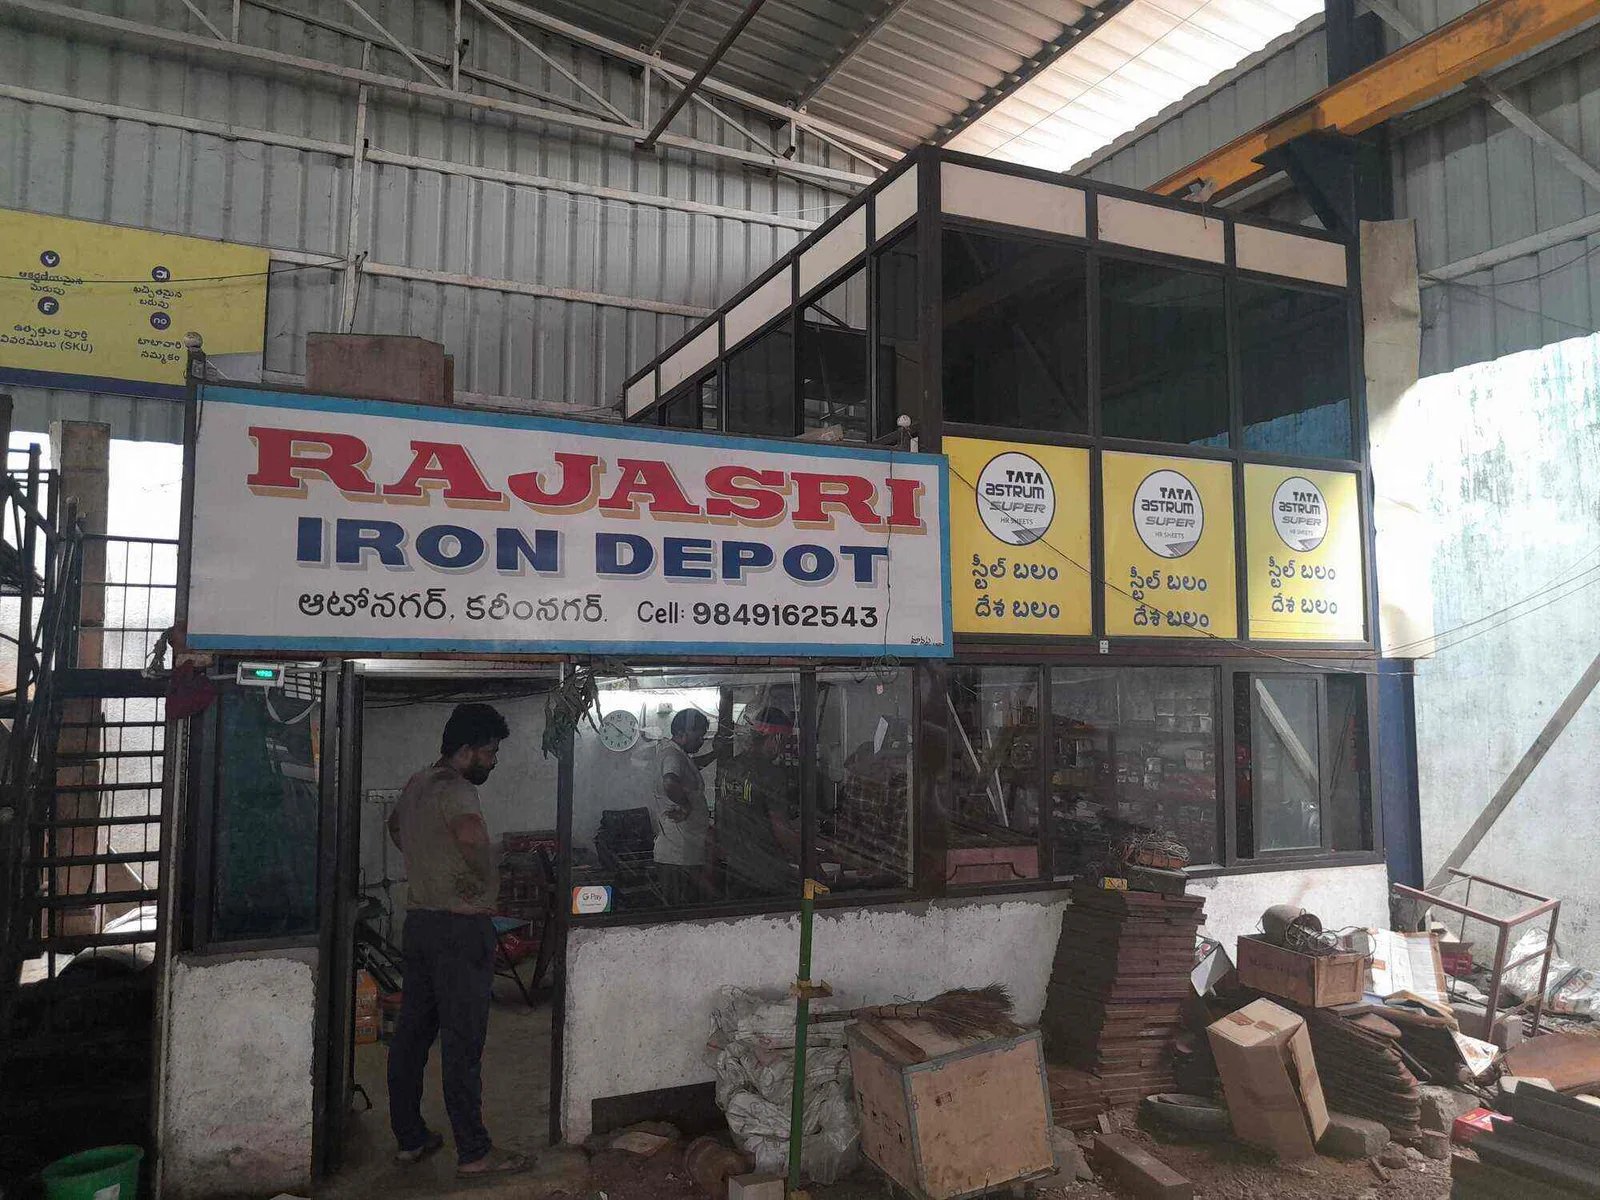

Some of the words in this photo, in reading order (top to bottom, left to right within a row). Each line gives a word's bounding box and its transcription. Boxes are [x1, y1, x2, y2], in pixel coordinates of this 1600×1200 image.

[60, 341, 94, 354] (SKU)
[246, 426, 926, 534] RAJASRI
[1006, 470, 1044, 485] TATA
[1159, 487, 1193, 501] TATA
[1292, 492, 1320, 503] TATA
[989, 501, 1047, 513] SUPER
[1145, 516, 1196, 528] SUPER
[1281, 516, 1322, 526] SUPER
[296, 516, 565, 577] IRON
[595, 531, 890, 588] DEPOT
[1013, 563, 1059, 580] బలం
[1300, 564, 1337, 580] బలం
[1167, 575, 1207, 592] బలం
[975, 594, 1006, 617] దేశ
[1012, 601, 1060, 619] బలం
[1271, 592, 1296, 613] దేశ
[1300, 598, 1338, 615] బలం
[637, 600, 685, 624] Cell:
[692, 602, 878, 627] 9849162543
[1133, 604, 1161, 626] దేశ
[1167, 610, 1209, 627] బలం
